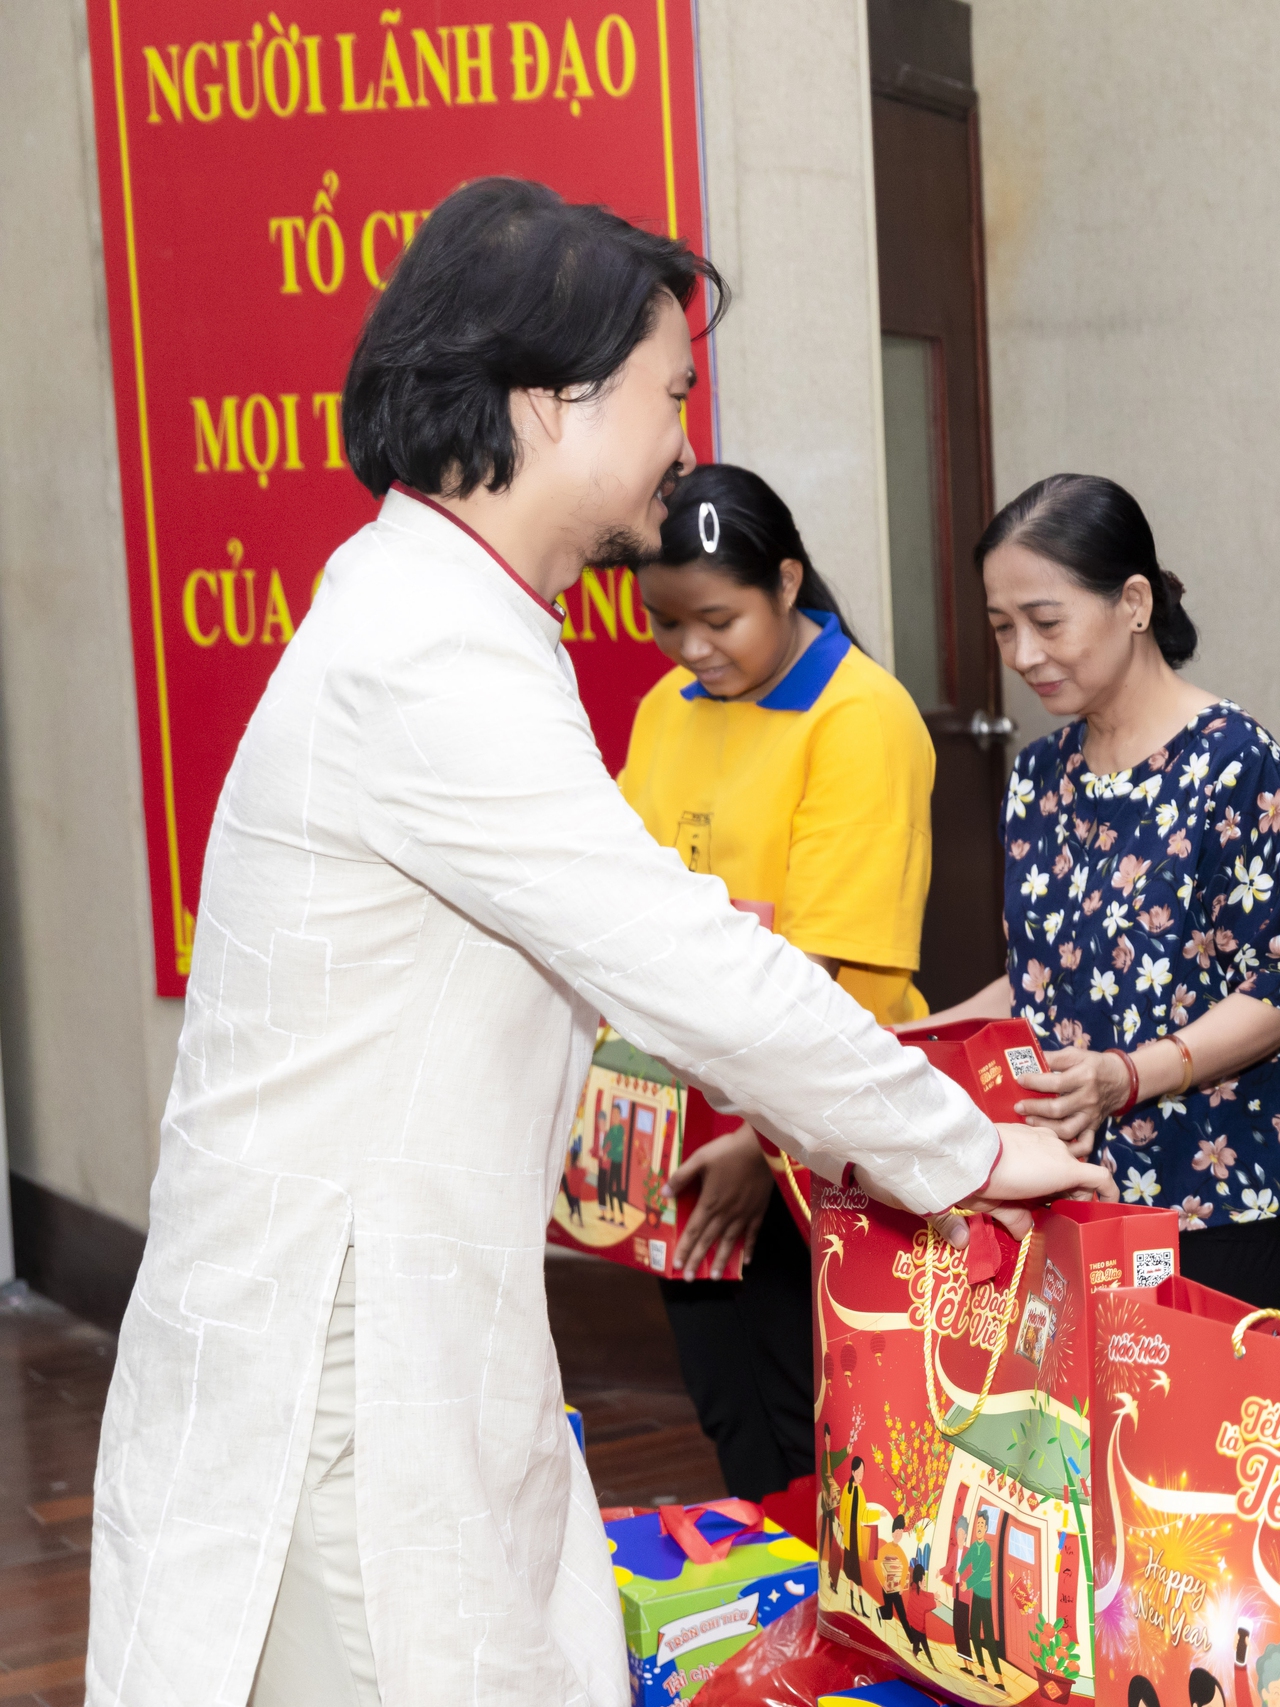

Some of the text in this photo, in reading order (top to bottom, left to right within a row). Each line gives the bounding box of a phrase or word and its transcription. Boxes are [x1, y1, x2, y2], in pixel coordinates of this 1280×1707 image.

[143, 9, 637, 124] NGƯỜI LÃNH ĐẠO
[269, 170, 345, 294] TỔ
[190, 393, 305, 489] MỌI
[182, 537, 296, 647] CỦA
[893, 1251, 914, 1278] là
[908, 1267, 971, 1338] Tết
[970, 1312, 1007, 1353] Viê
[1108, 1333, 1170, 1365] Hảo Hảo
[1216, 1421, 1244, 1457] là
[1145, 1546, 1207, 1611] Happy
[700, 1617, 721, 1633] CHI
[1135, 1591, 1212, 1652] New Year
[662, 1669, 688, 1697] Tài
